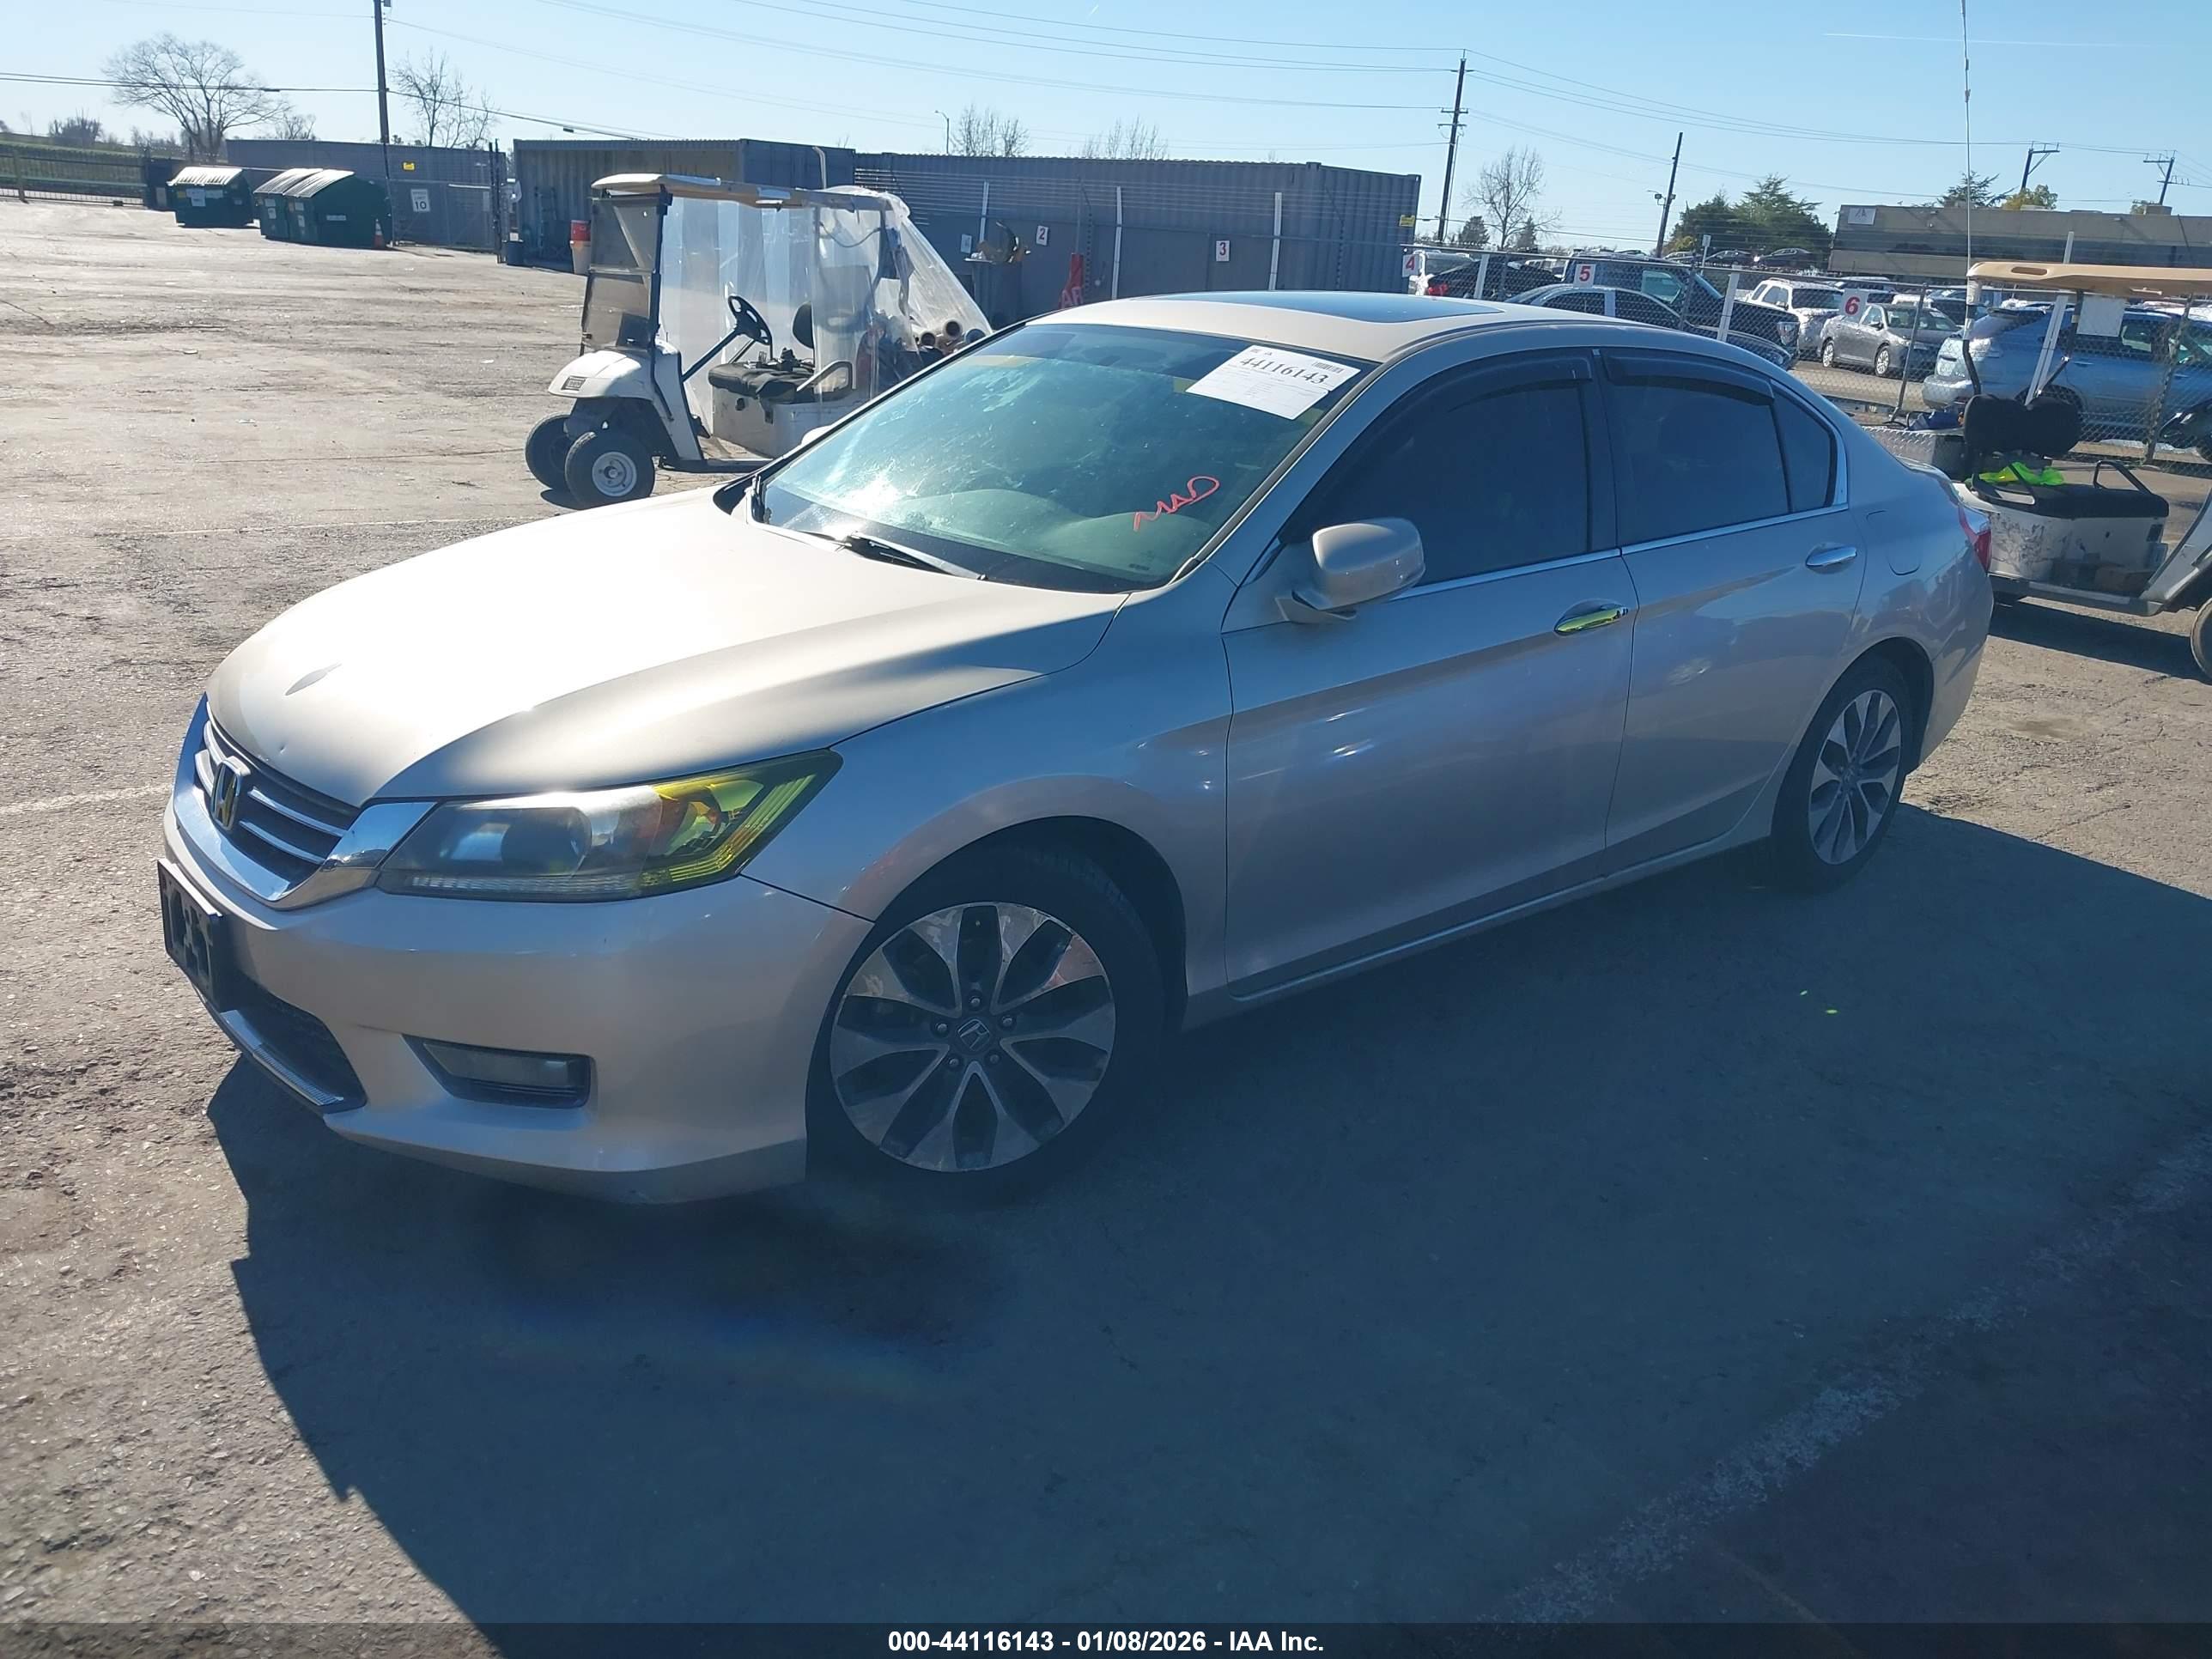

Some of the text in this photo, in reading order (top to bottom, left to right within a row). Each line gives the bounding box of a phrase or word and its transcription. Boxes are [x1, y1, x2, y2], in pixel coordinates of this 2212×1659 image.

[415, 201, 427, 210] 10
[1039, 228, 1046, 240] 2
[1219, 241, 1226, 256] 3
[1406, 256, 1416, 270] 4
[1579, 265, 1591, 282] 5
[1845, 296, 1860, 315] 6
[1240, 357, 1329, 385] 44116143
